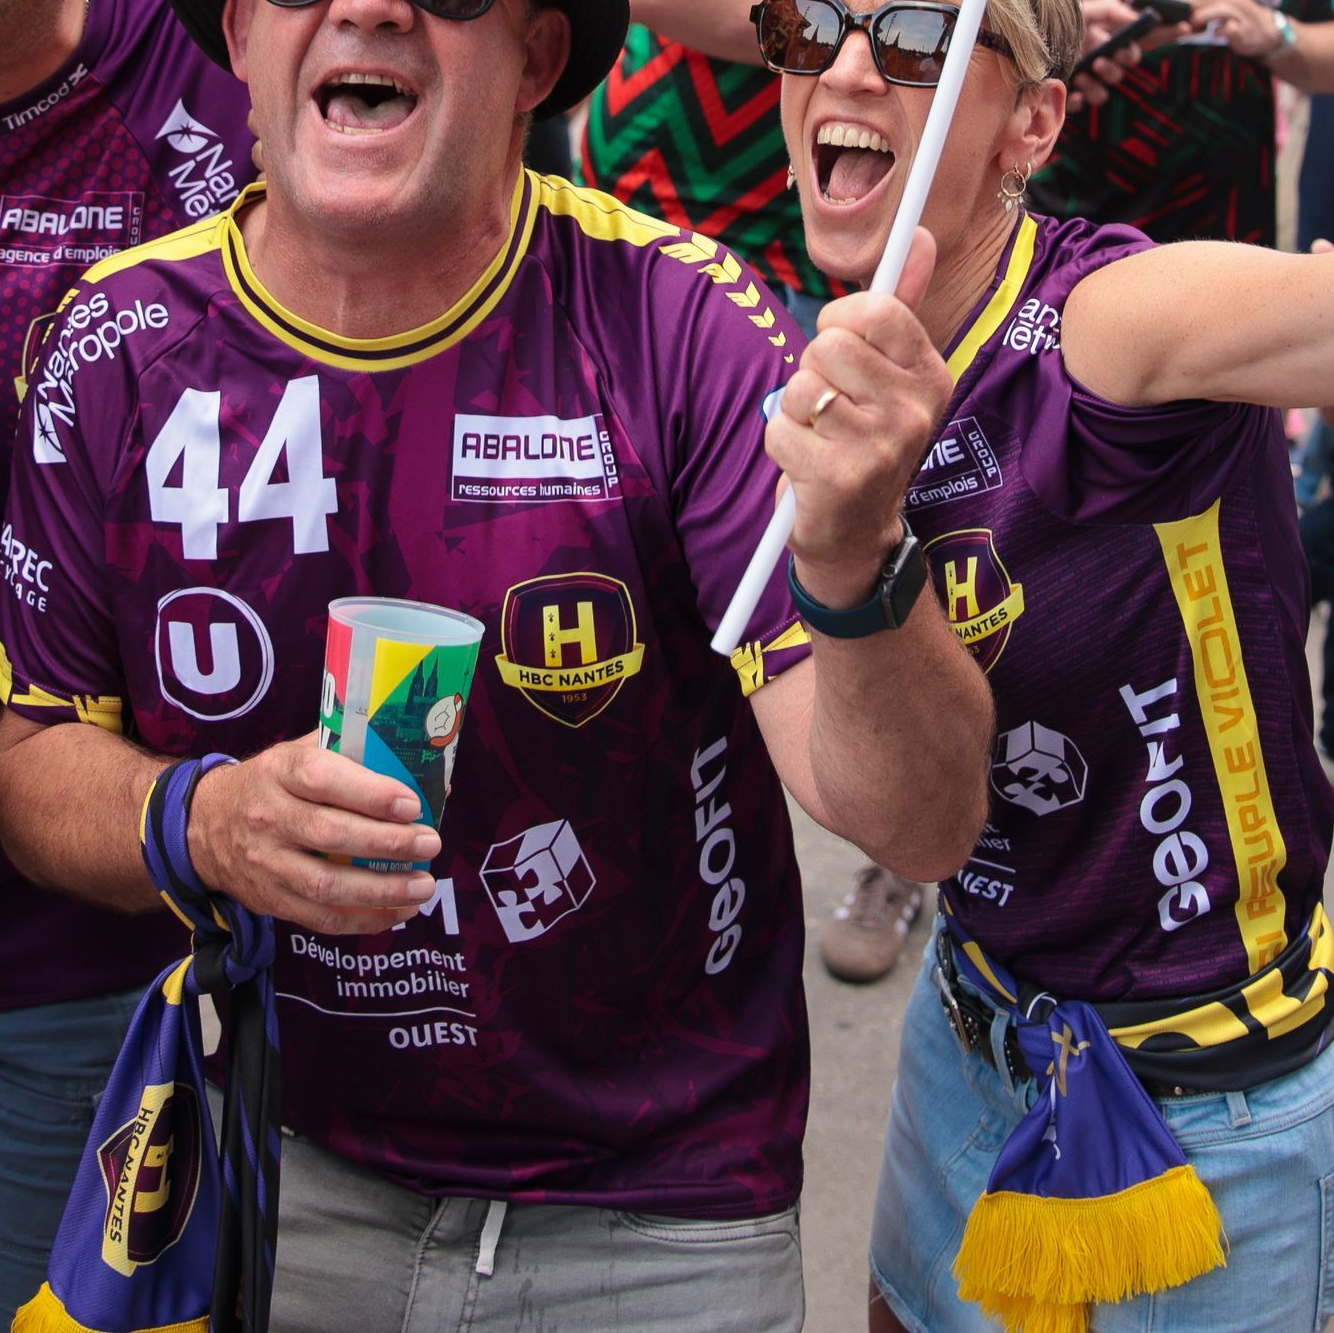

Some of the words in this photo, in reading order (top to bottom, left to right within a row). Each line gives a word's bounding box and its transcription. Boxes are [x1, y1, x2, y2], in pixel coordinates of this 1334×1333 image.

[1, 206, 124, 235] ABALONE
[130, 207, 140, 245] GROU
[37, 292, 109, 400] Nanes
[48, 300, 169, 428] Mropole
[146, 374, 339, 560] 44
[461, 432, 596, 462] ABALONE
[599, 430, 619, 488] GROUP
[968, 431, 997, 478] GROUP
[458, 481, 537, 497] ressources
[539, 481, 601, 497] humaines
[909, 474, 979, 505] d'emplois
[1177, 540, 1245, 734] VIOLET
[519, 669, 554, 688] HBC
[559, 660, 625, 687] NANTES
[561, 692, 588, 704] 1953
[957, 869, 1014, 907] UEST
[291, 934, 467, 977] Développement
[336, 971, 470, 999] immobilier
[388, 1022, 478, 1050] OUEST
[131, 1107, 154, 1150] HBC
[110, 1153, 135, 1244] NANTES
